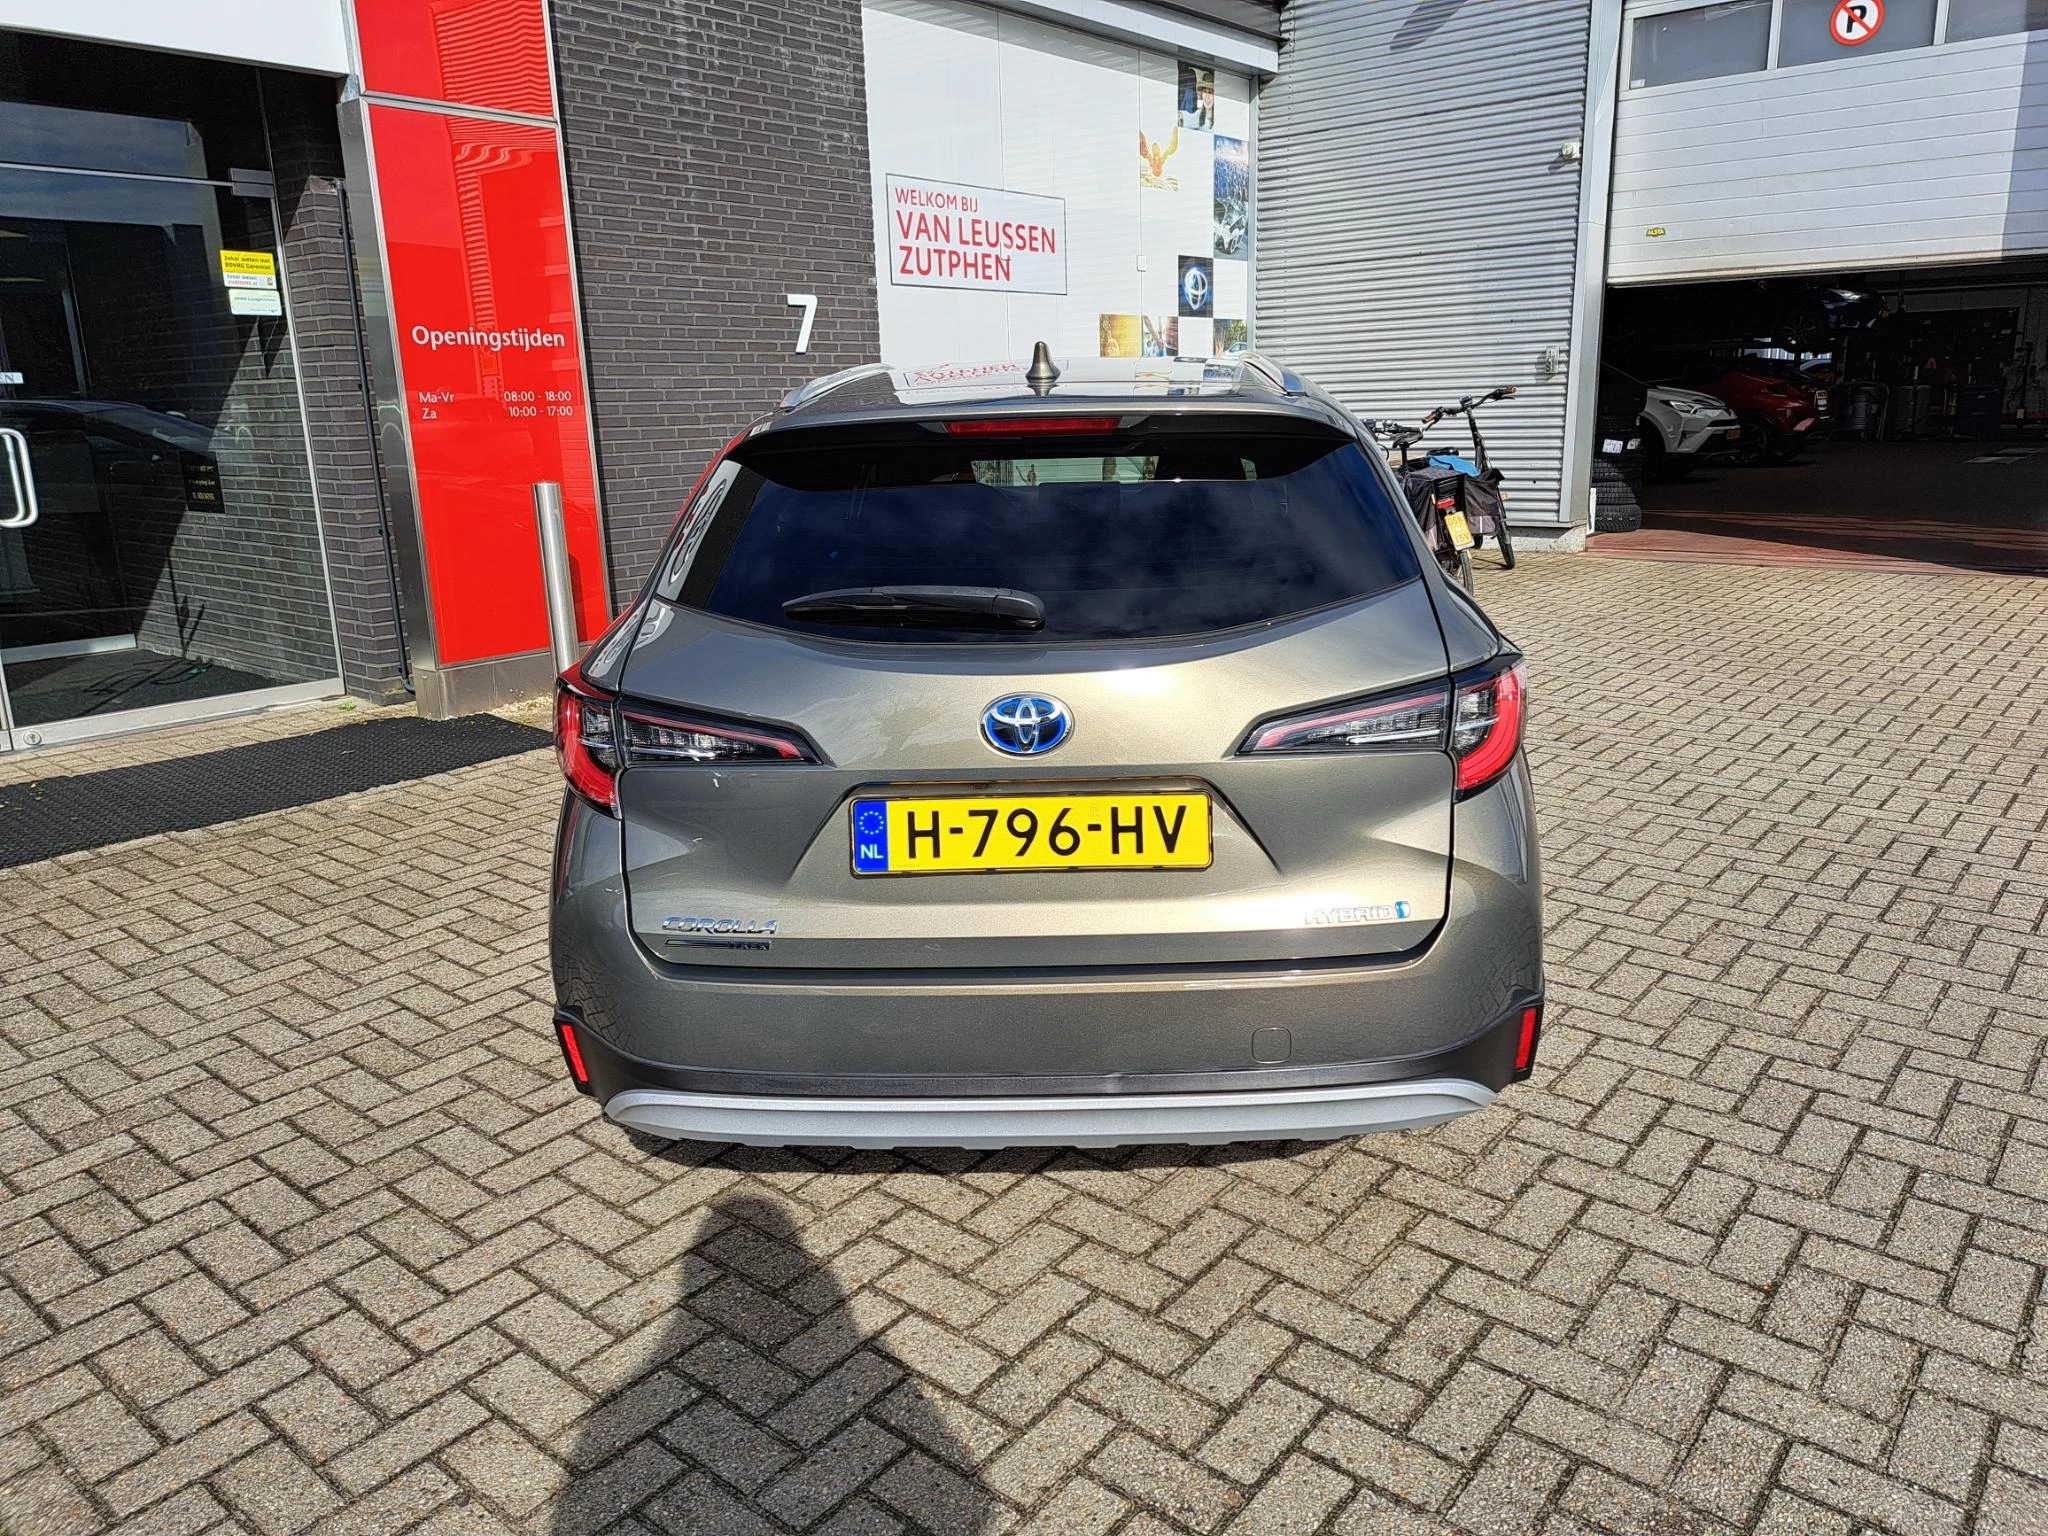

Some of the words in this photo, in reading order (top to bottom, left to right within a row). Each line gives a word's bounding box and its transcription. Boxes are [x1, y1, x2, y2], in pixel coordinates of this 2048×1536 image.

[895, 187, 958, 211] WELKOM
[961, 197, 979, 213] BIJ
[896, 209, 951, 244] VAN
[958, 217, 1056, 254] LEUSSEN
[899, 245, 1011, 282] ZUTPHEN
[787, 294, 818, 353] 7
[411, 325, 566, 352] Openingstijden
[419, 391, 455, 404] Ma-Vr
[504, 390, 535, 402] 08:00
[545, 390, 572, 402] 18:00
[422, 407, 437, 420] Za
[509, 405, 537, 417] 10:00
[547, 405, 573, 416] 17:00
[907, 805, 1187, 859] H-796-HV
[860, 844, 884, 860] NL
[662, 916, 778, 935] COROLLA
[1304, 904, 1394, 925] HYBRID
